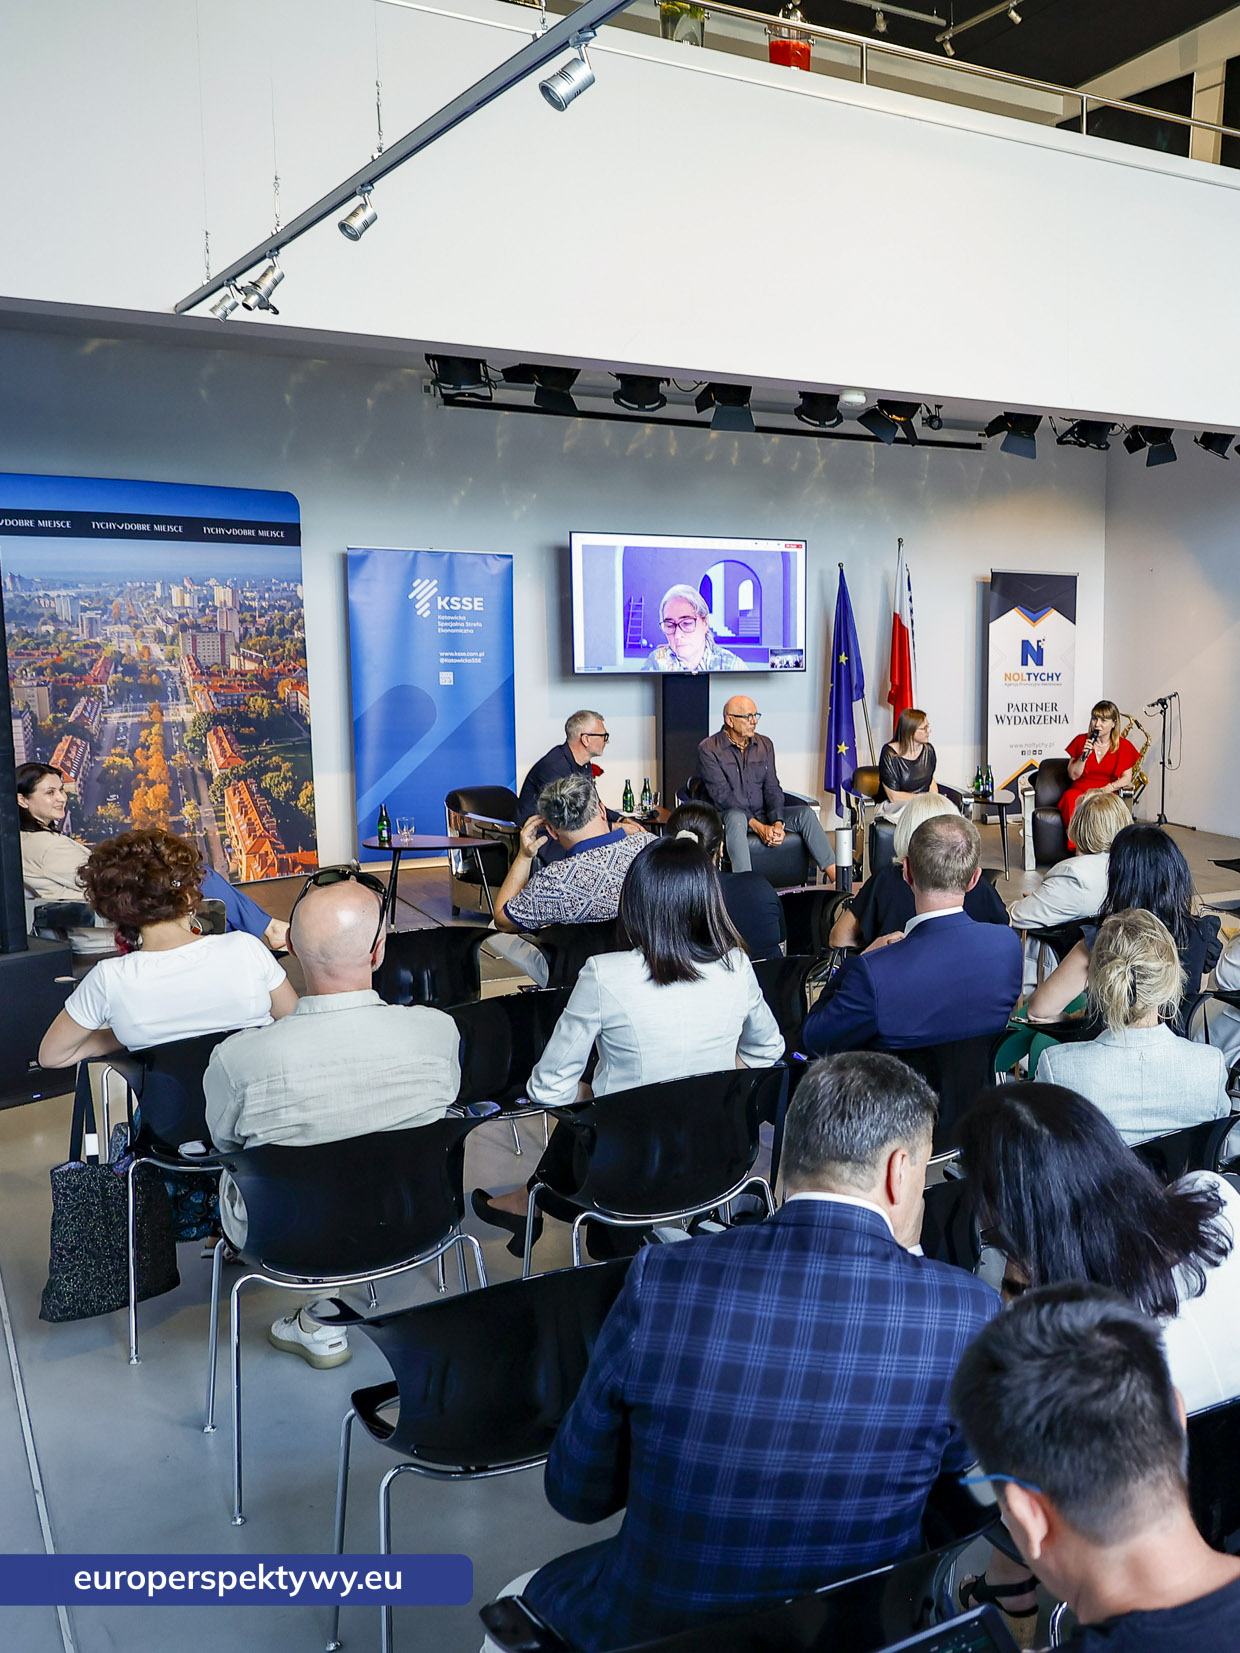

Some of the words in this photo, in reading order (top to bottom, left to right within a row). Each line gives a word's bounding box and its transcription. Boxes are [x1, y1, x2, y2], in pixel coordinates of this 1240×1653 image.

[5, 519, 36, 527] DOBRE
[38, 520, 72, 528] MIEJSCE
[124, 522, 151, 531] DOBRE
[153, 524, 184, 533] MIEJSCE
[232, 528, 256, 536] DOBRE
[258, 530, 285, 538] MIEJSCE
[437, 596, 484, 611] KSSE
[1004, 672, 1062, 681] NOLTYCHY
[1007, 702, 1058, 712] PARTNER
[994, 713, 1070, 726] WYDARZENIA
